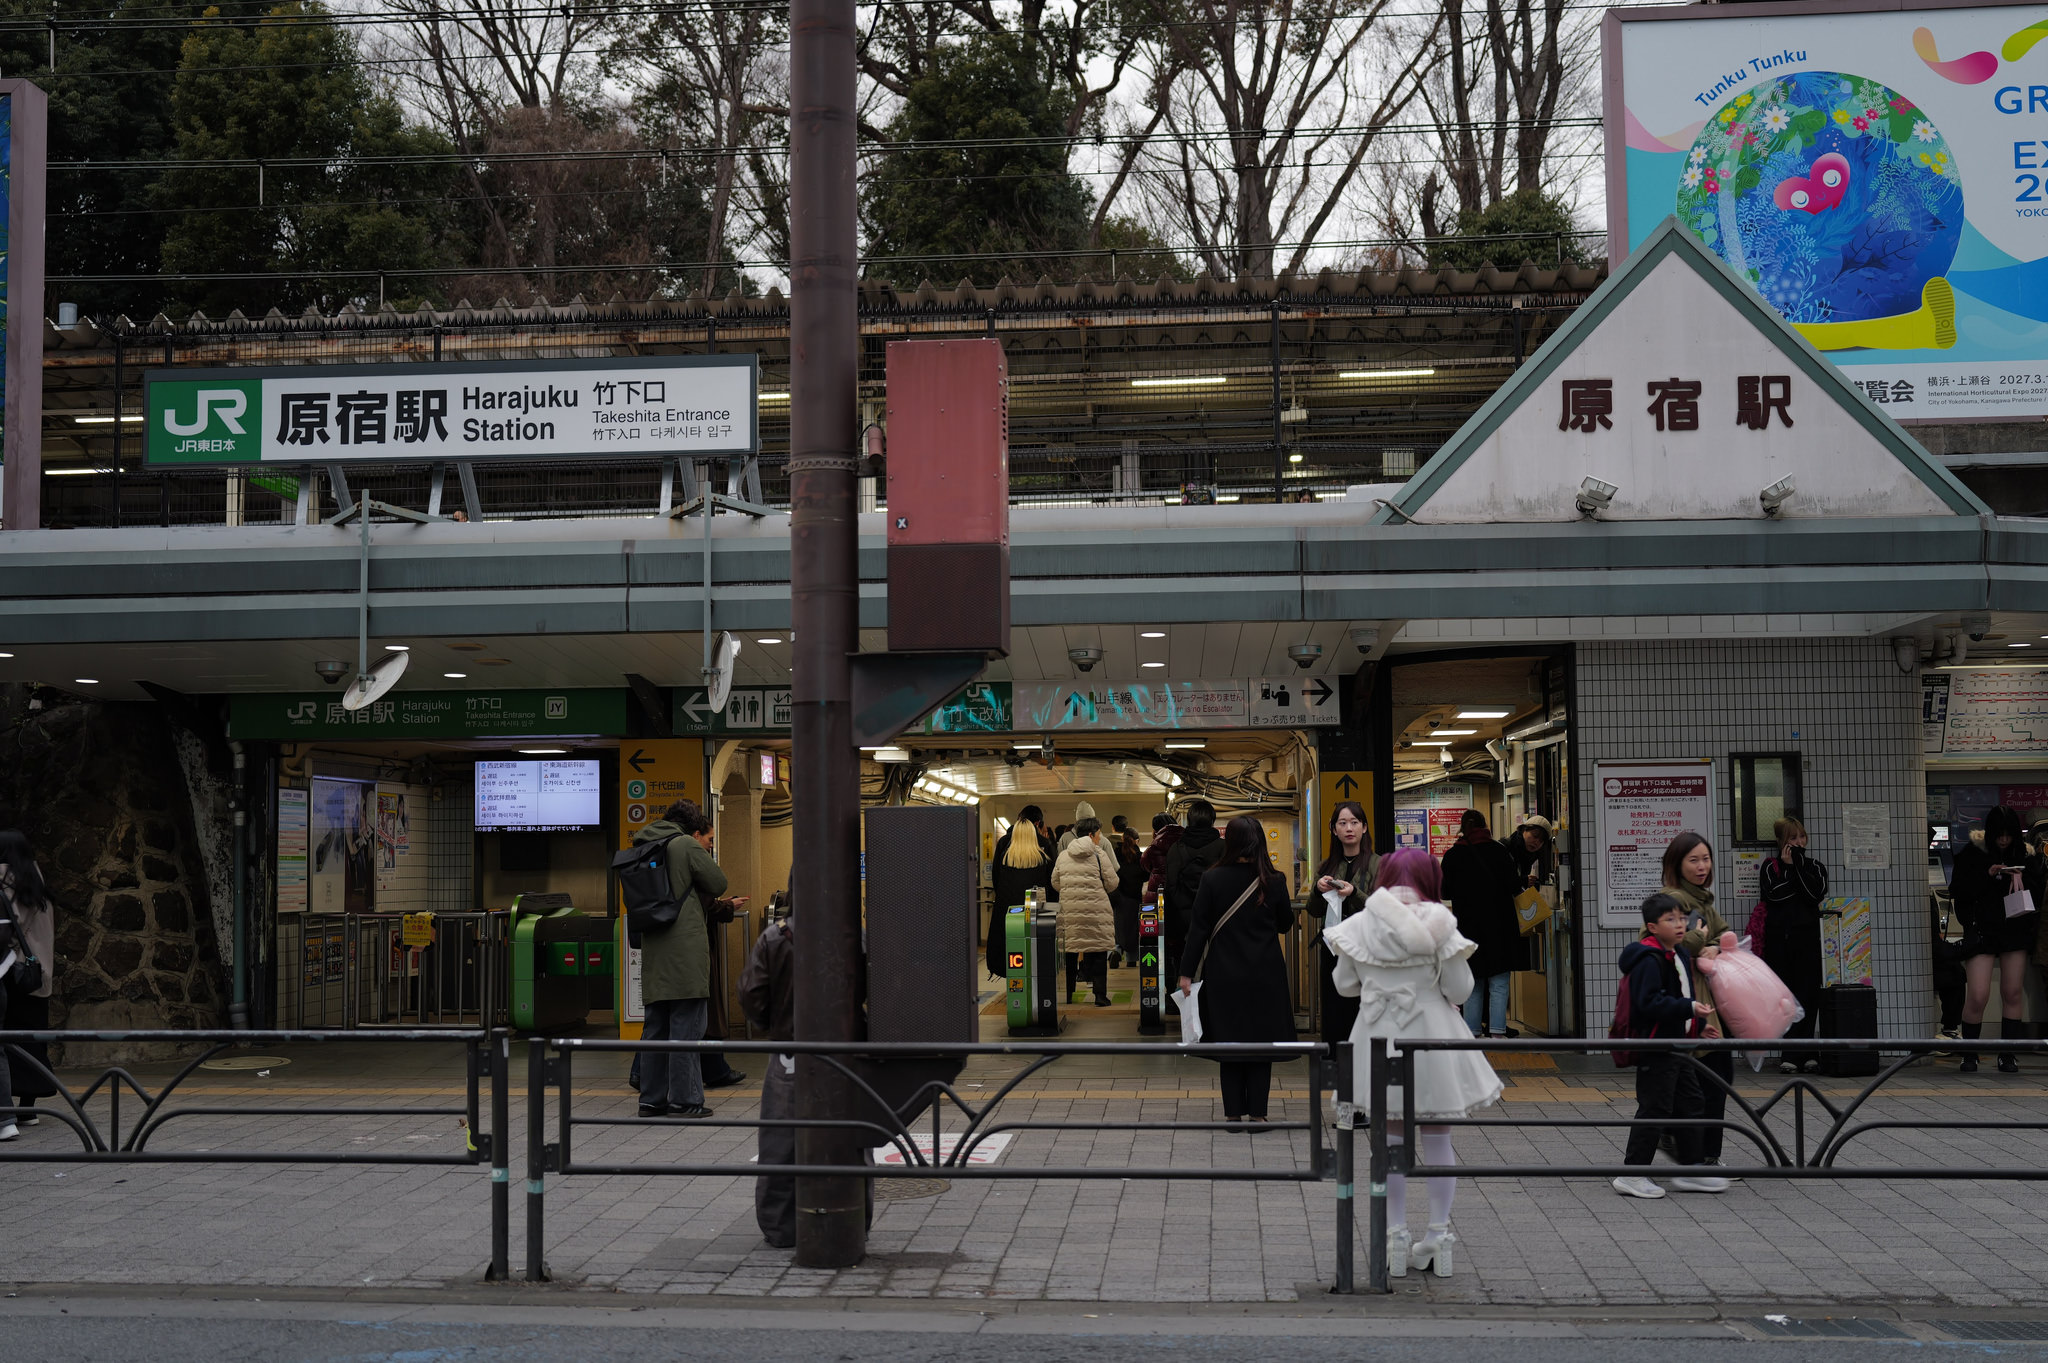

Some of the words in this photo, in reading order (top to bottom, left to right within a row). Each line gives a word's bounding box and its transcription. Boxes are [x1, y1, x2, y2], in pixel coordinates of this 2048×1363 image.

[1694, 69, 1747, 106] Tunku
[1748, 50, 1807, 73] Tunku
[2015, 173, 2048, 203] 2
[1927, 375, 1991, 387] 横浜・上瀬谷
[1999, 374, 2048, 385] 2027.3.
[593, 381, 666, 406] 竹下口
[2012, 388, 2029, 396] Expo
[463, 385, 578, 414] Harajuku
[1558, 375, 1794, 432] 原宿駅
[164, 389, 247, 436] JR
[276, 390, 449, 446] 原宿駅
[593, 409, 660, 423] Takeshita
[666, 408, 730, 422] Entrance
[463, 418, 555, 442] Station
[592, 427, 641, 441] 竹下入口
[650, 425, 702, 439] 다케시타
[707, 424, 733, 438] 입구
[175, 439, 236, 453] JR東日本
[465, 697, 502, 710] 竹下口
[1094, 692, 1133, 704] 山手線
[1157, 693, 1243, 703] エスカレーターはありません
[287, 701, 317, 720] JR
[325, 701, 396, 724] 原宿駅
[402, 700, 451, 714] Harajuku
[549, 703, 562, 713] JY
[1202, 704, 1233, 713] Escalator
[402, 713, 440, 724] Station
[465, 711, 500, 720] Takeshita
[502, 710, 536, 719] Entrance
[1252, 714, 1307, 725] きっぷ売り場
[1311, 714, 1338, 723] Tickets
[686, 723, 712, 732] (150m)
[649, 781, 685, 791] 千代田線
[1622, 787, 1692, 795] インターホン対応のお知らせ
[2006, 789, 2048, 799] チャージ
[649, 805, 668, 814] 副都
[1009, 954, 1024, 968] IC
